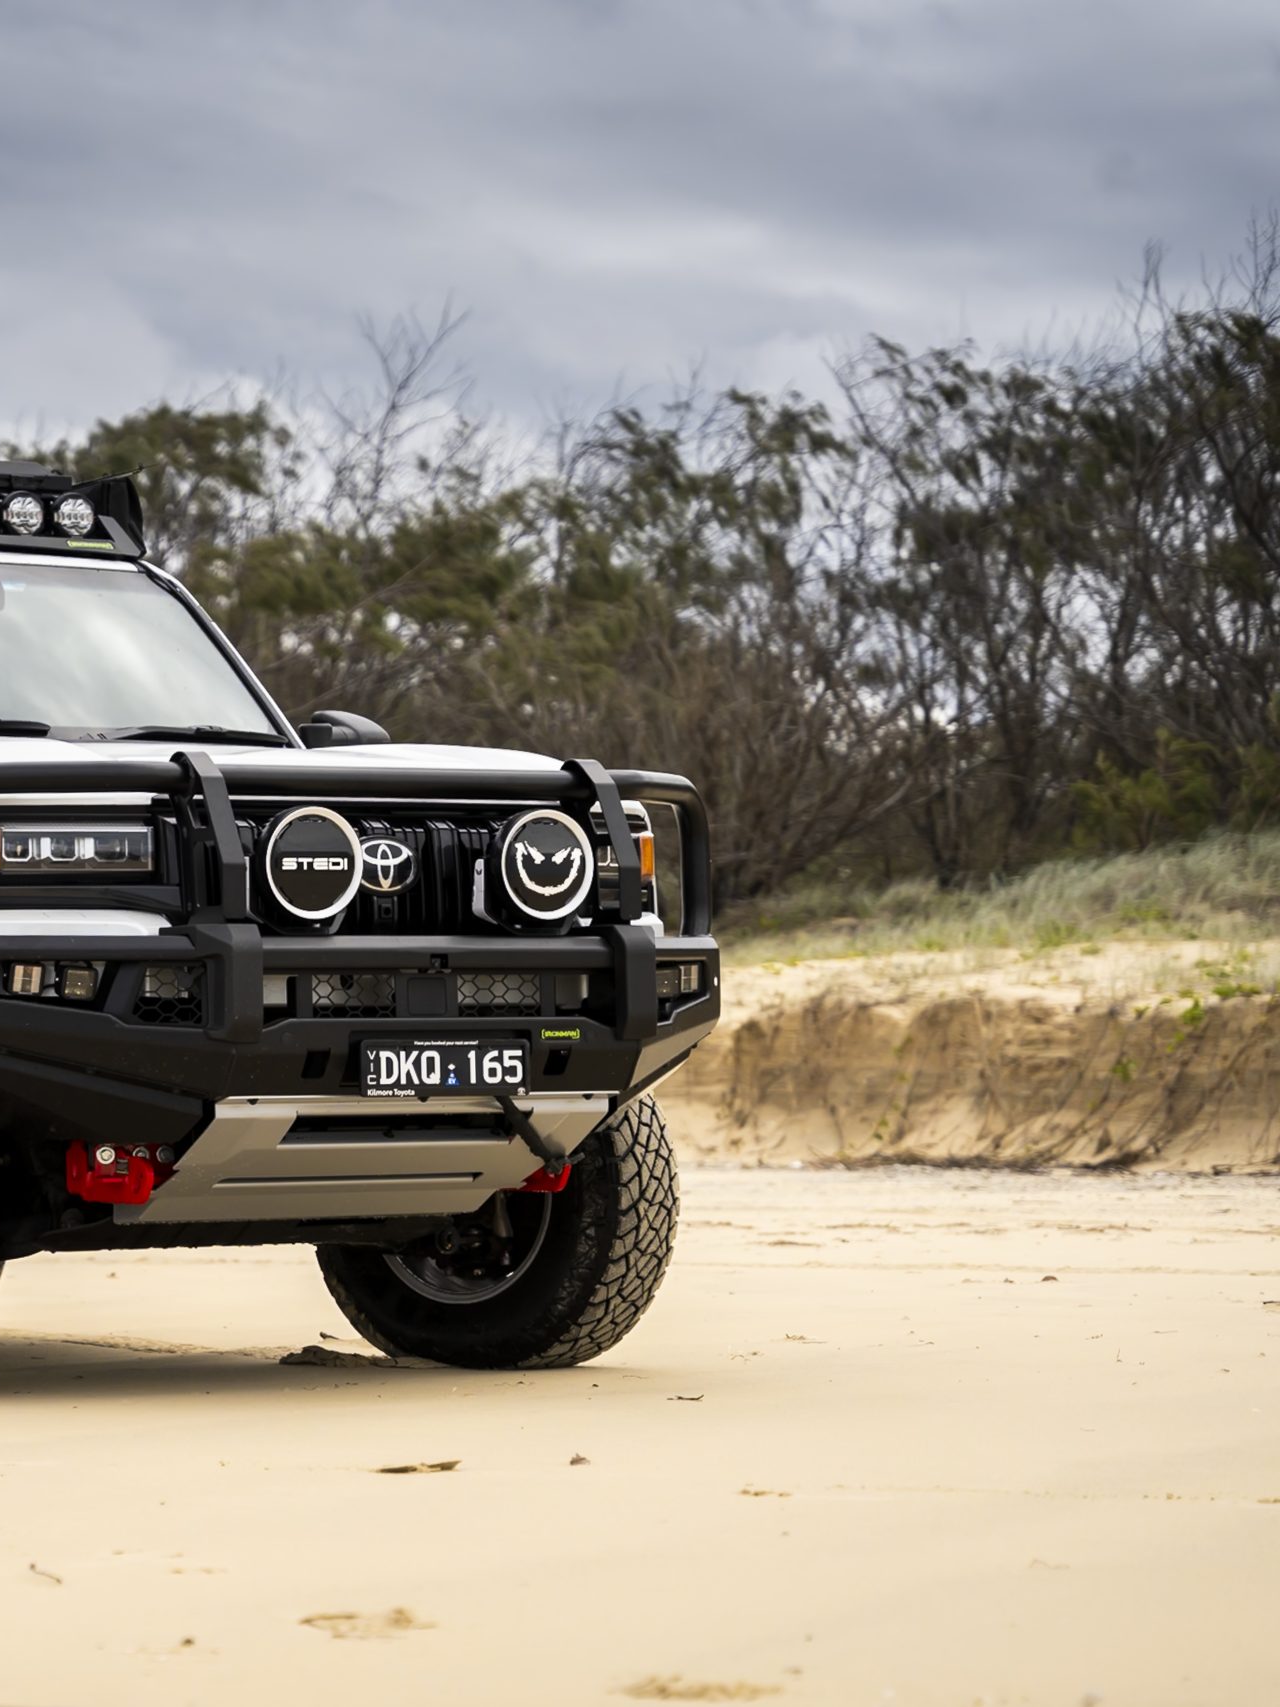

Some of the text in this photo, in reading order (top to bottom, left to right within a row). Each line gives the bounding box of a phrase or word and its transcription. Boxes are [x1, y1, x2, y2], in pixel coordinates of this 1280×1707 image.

[281, 858, 348, 871] STEDI
[367, 1050, 377, 1085] VIC
[379, 1049, 523, 1085] DKQ 165
[393, 1089, 415, 1097] Toyota
